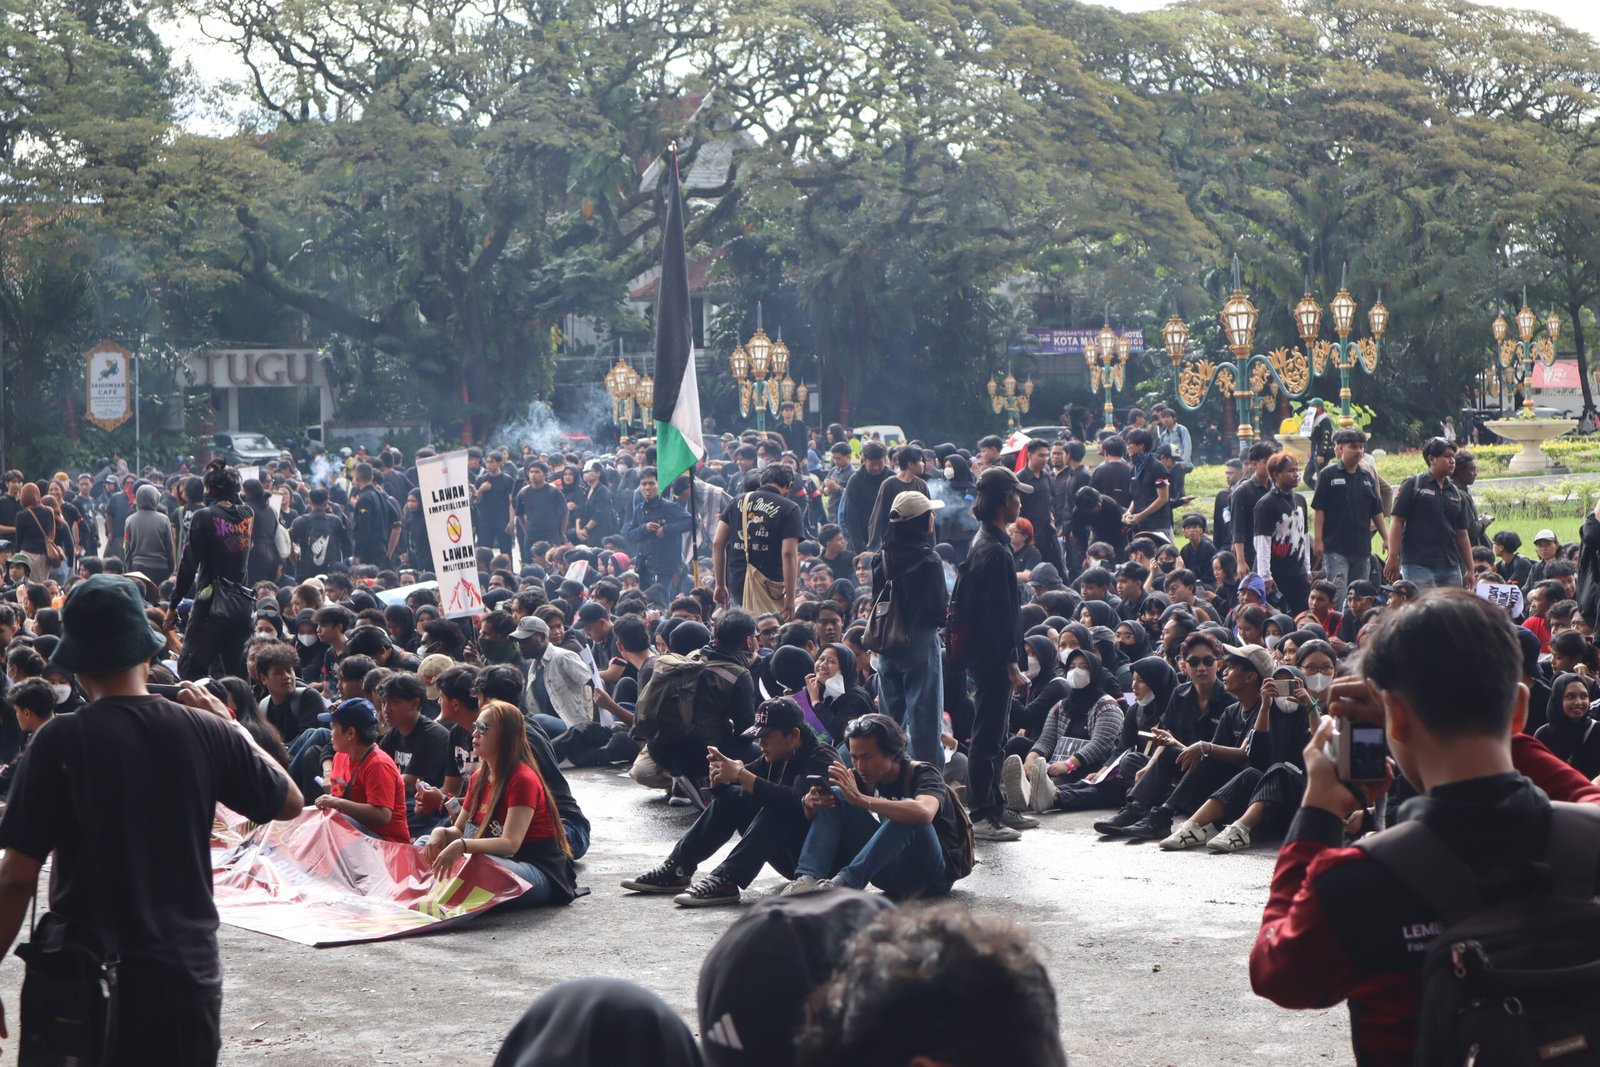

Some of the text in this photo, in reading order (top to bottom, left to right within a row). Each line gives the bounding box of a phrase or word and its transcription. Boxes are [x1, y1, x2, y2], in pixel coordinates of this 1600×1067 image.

[1053, 336, 1079, 346] KOTA
[204, 353, 315, 385] TUGU
[431, 484, 466, 503] LAWAN
[442, 544, 475, 563] LAWAN
